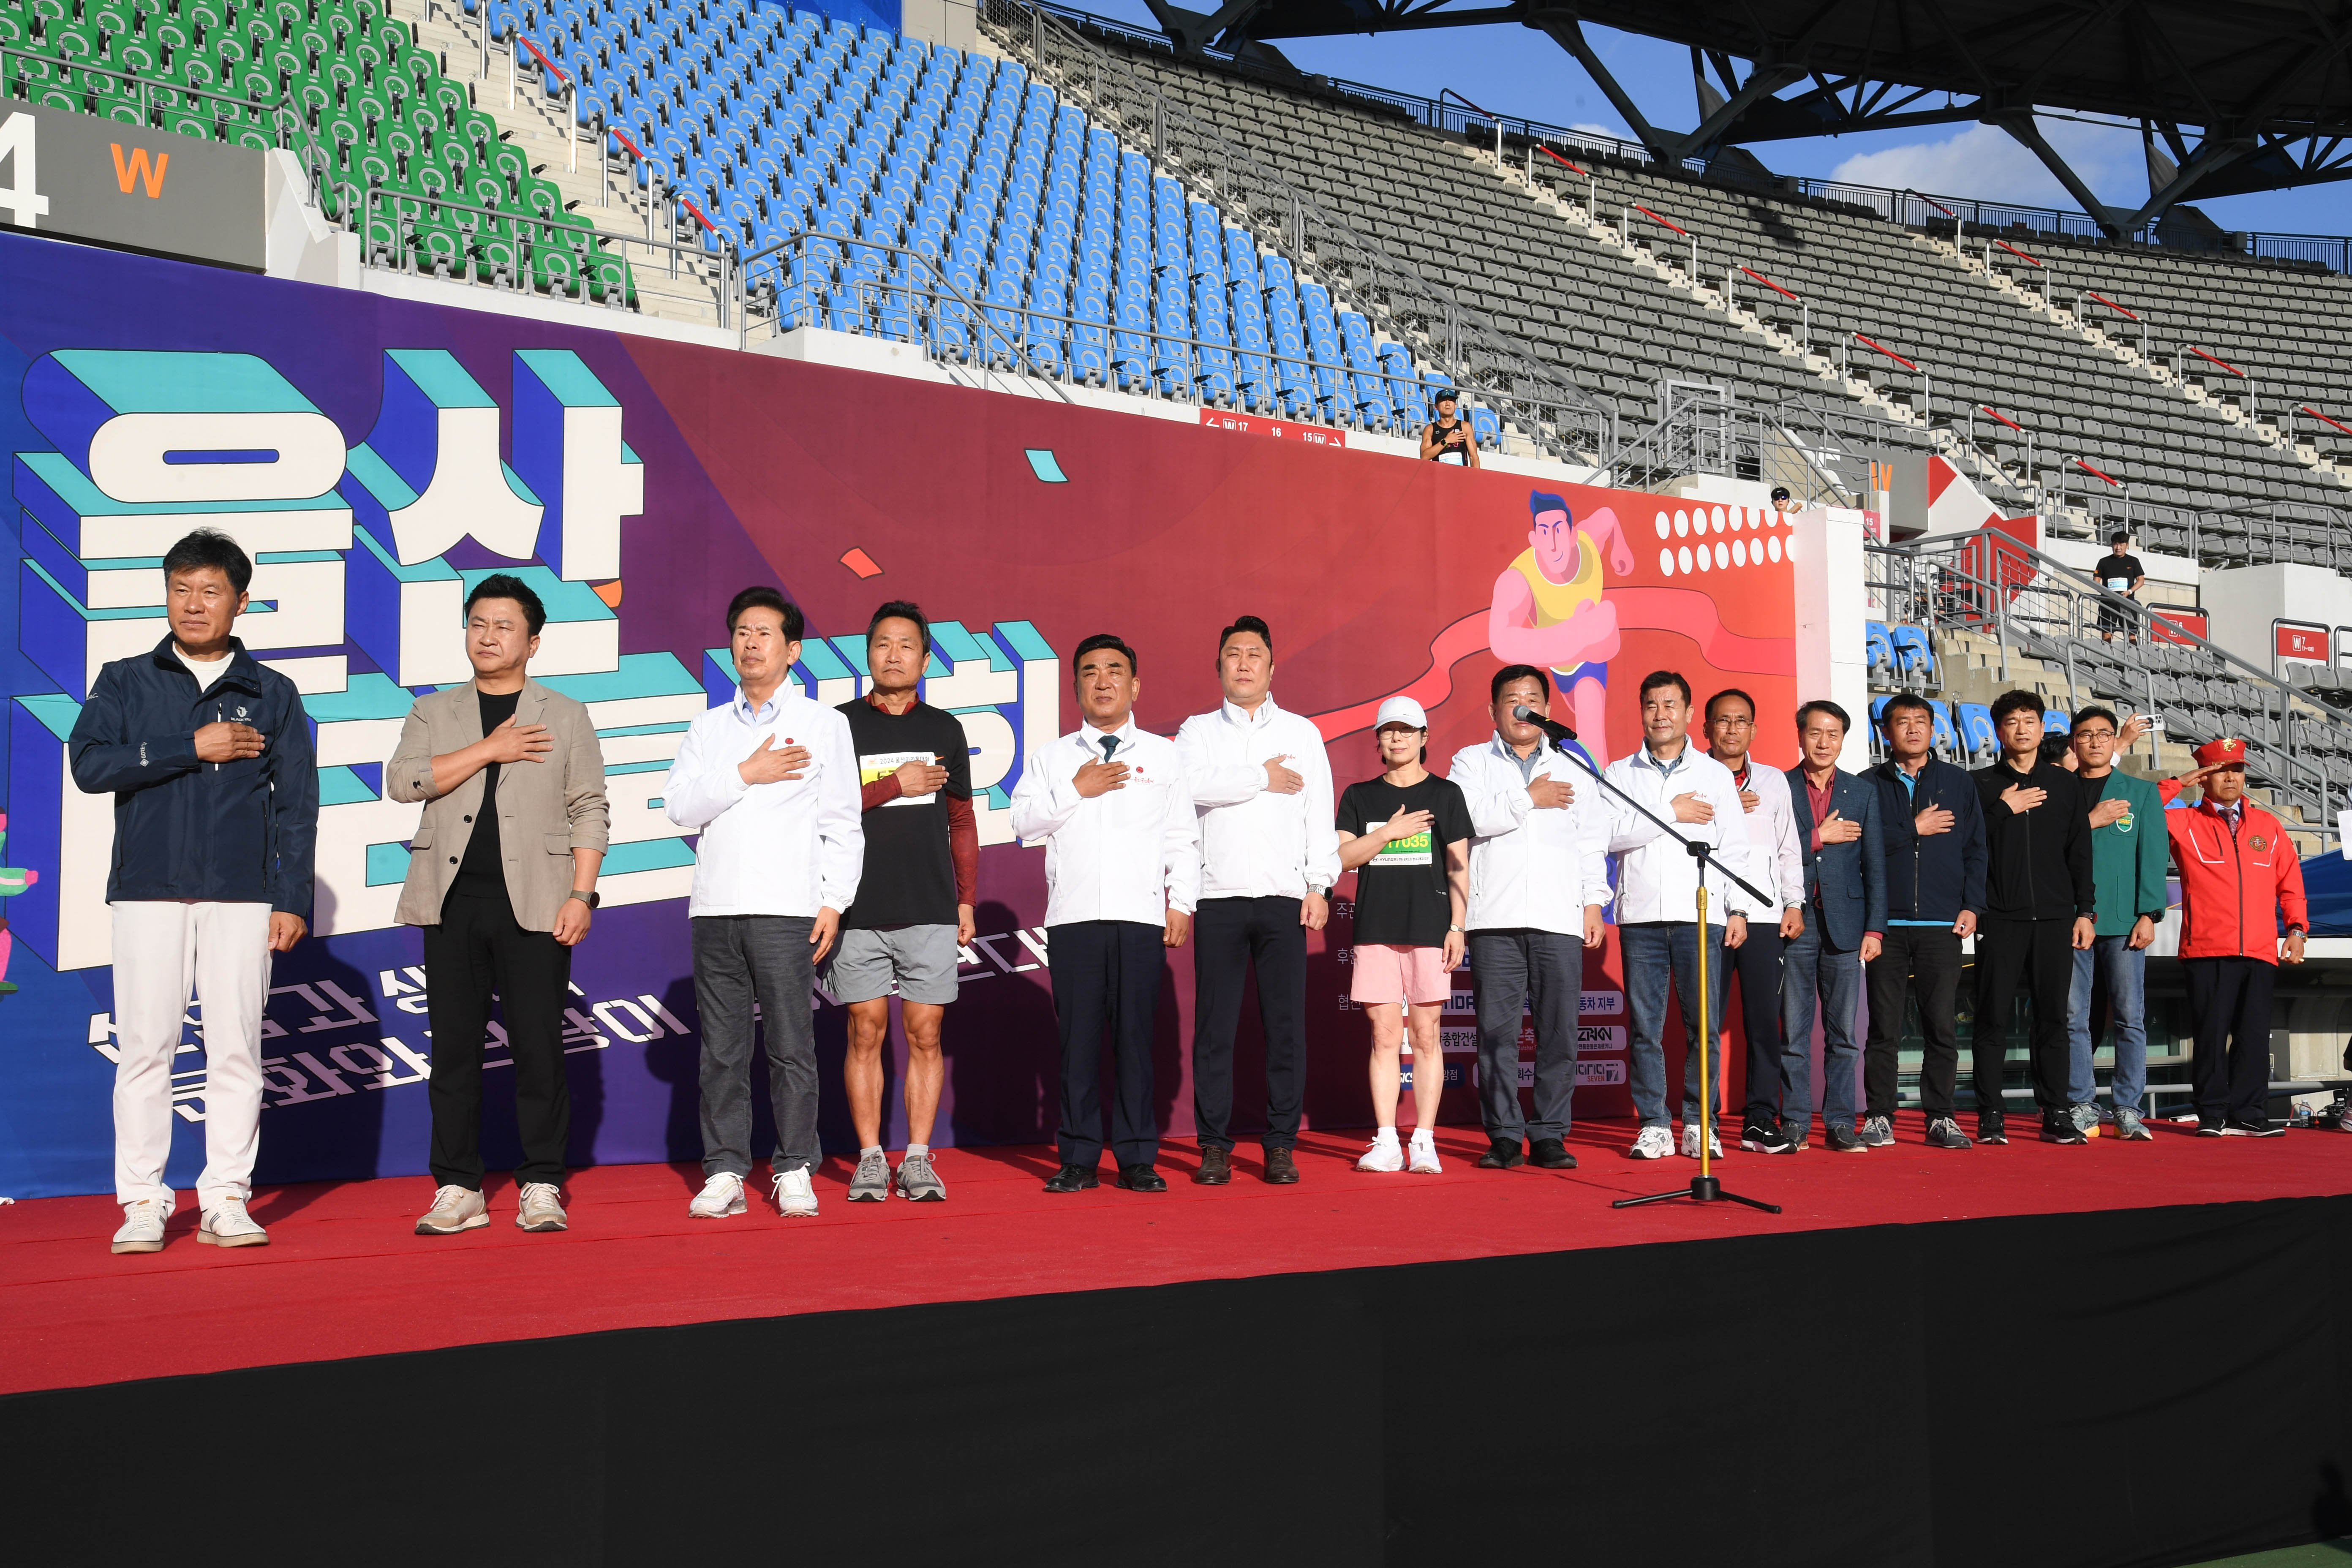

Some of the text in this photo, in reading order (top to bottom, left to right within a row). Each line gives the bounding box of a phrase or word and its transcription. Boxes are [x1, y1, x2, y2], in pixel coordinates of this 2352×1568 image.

[110, 143, 169, 198] W
[1238, 422, 1248, 432] 17
[1271, 427, 1281, 437] 16
[1302, 432, 1312, 442] 15
[1865, 517, 1873, 526] 15
[42, 380, 644, 700] 울산
[2293, 637, 2306, 649] W 7
[1598, 996, 1615, 1011] 지부
